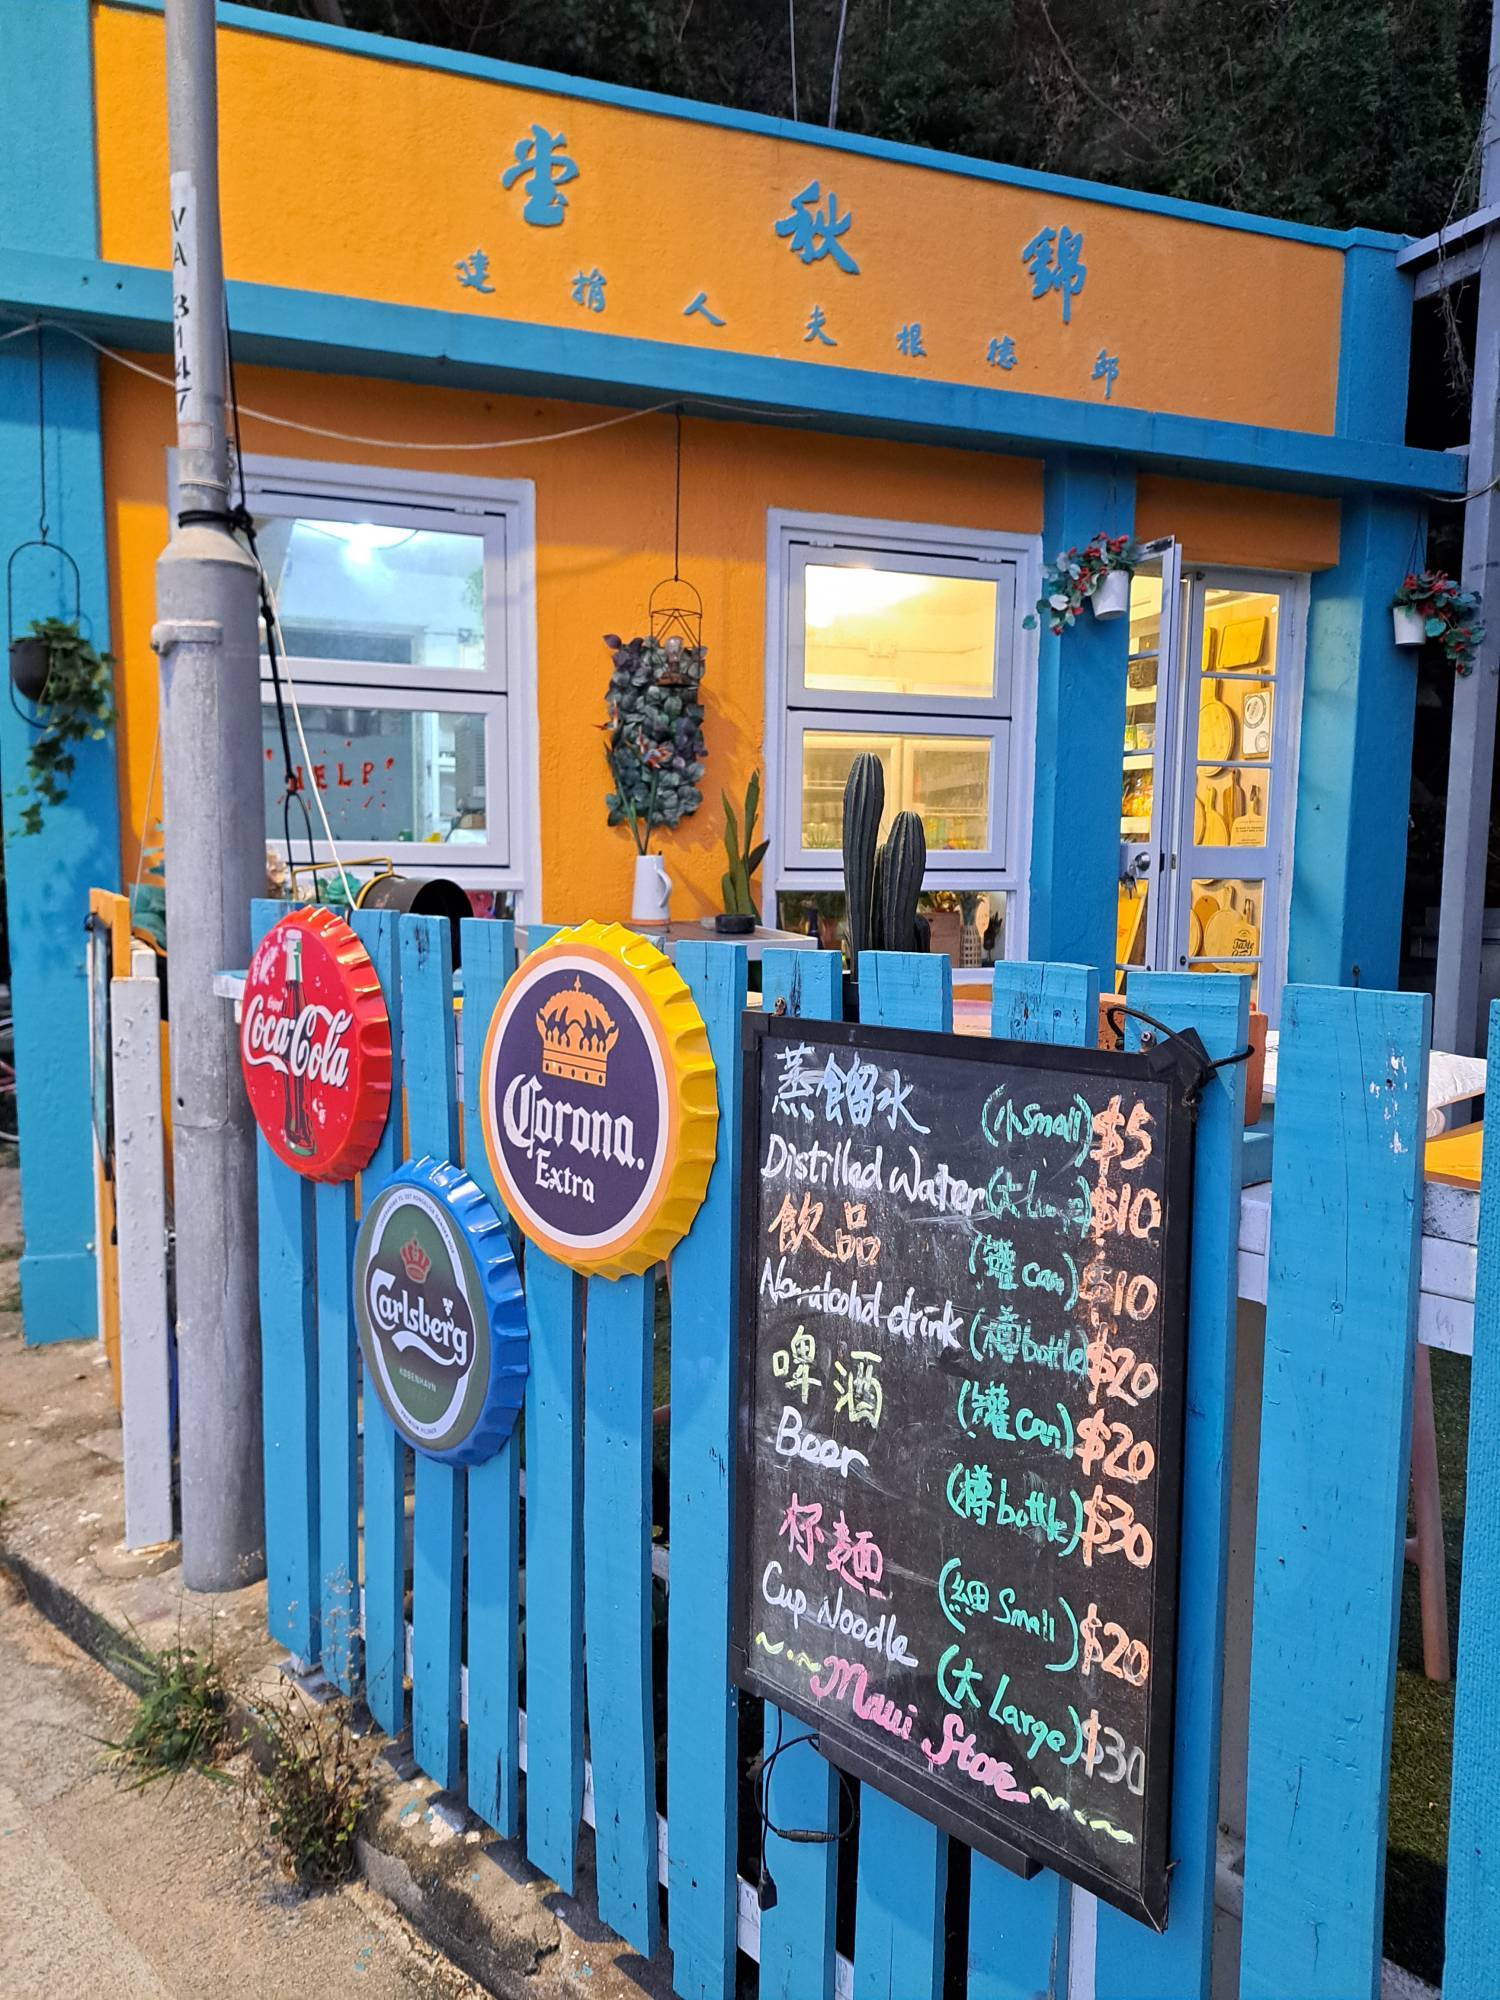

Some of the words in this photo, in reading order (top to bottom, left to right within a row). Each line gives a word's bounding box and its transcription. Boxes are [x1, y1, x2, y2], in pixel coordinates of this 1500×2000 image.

[244, 995, 352, 1088] Coca-Cola
[536, 1148, 595, 1203] Extra
[761, 1133, 883, 1191] Distilled
[890, 1146, 985, 1216] Water
[1090, 1094, 1152, 1176] $5
[768, 1191, 881, 1267] 飲品
[1090, 1176, 1161, 1245] $10
[370, 1268, 468, 1366] Carlsberg
[887, 1287, 964, 1350] drink
[1079, 1250, 1158, 1327] $10
[773, 1325, 883, 1431] 啤酒
[1087, 1322, 1159, 1407] $20
[776, 1406, 870, 1478] Beer
[1076, 1409, 1155, 1484] $20
[1083, 1485, 1153, 1568] $30
[762, 1560, 806, 1622] Cup
[817, 1587, 919, 1667] Noodle
[1080, 1603, 1149, 1686] $20
[921, 1713, 1031, 1804] Store
[1081, 1709, 1145, 1795] $30
